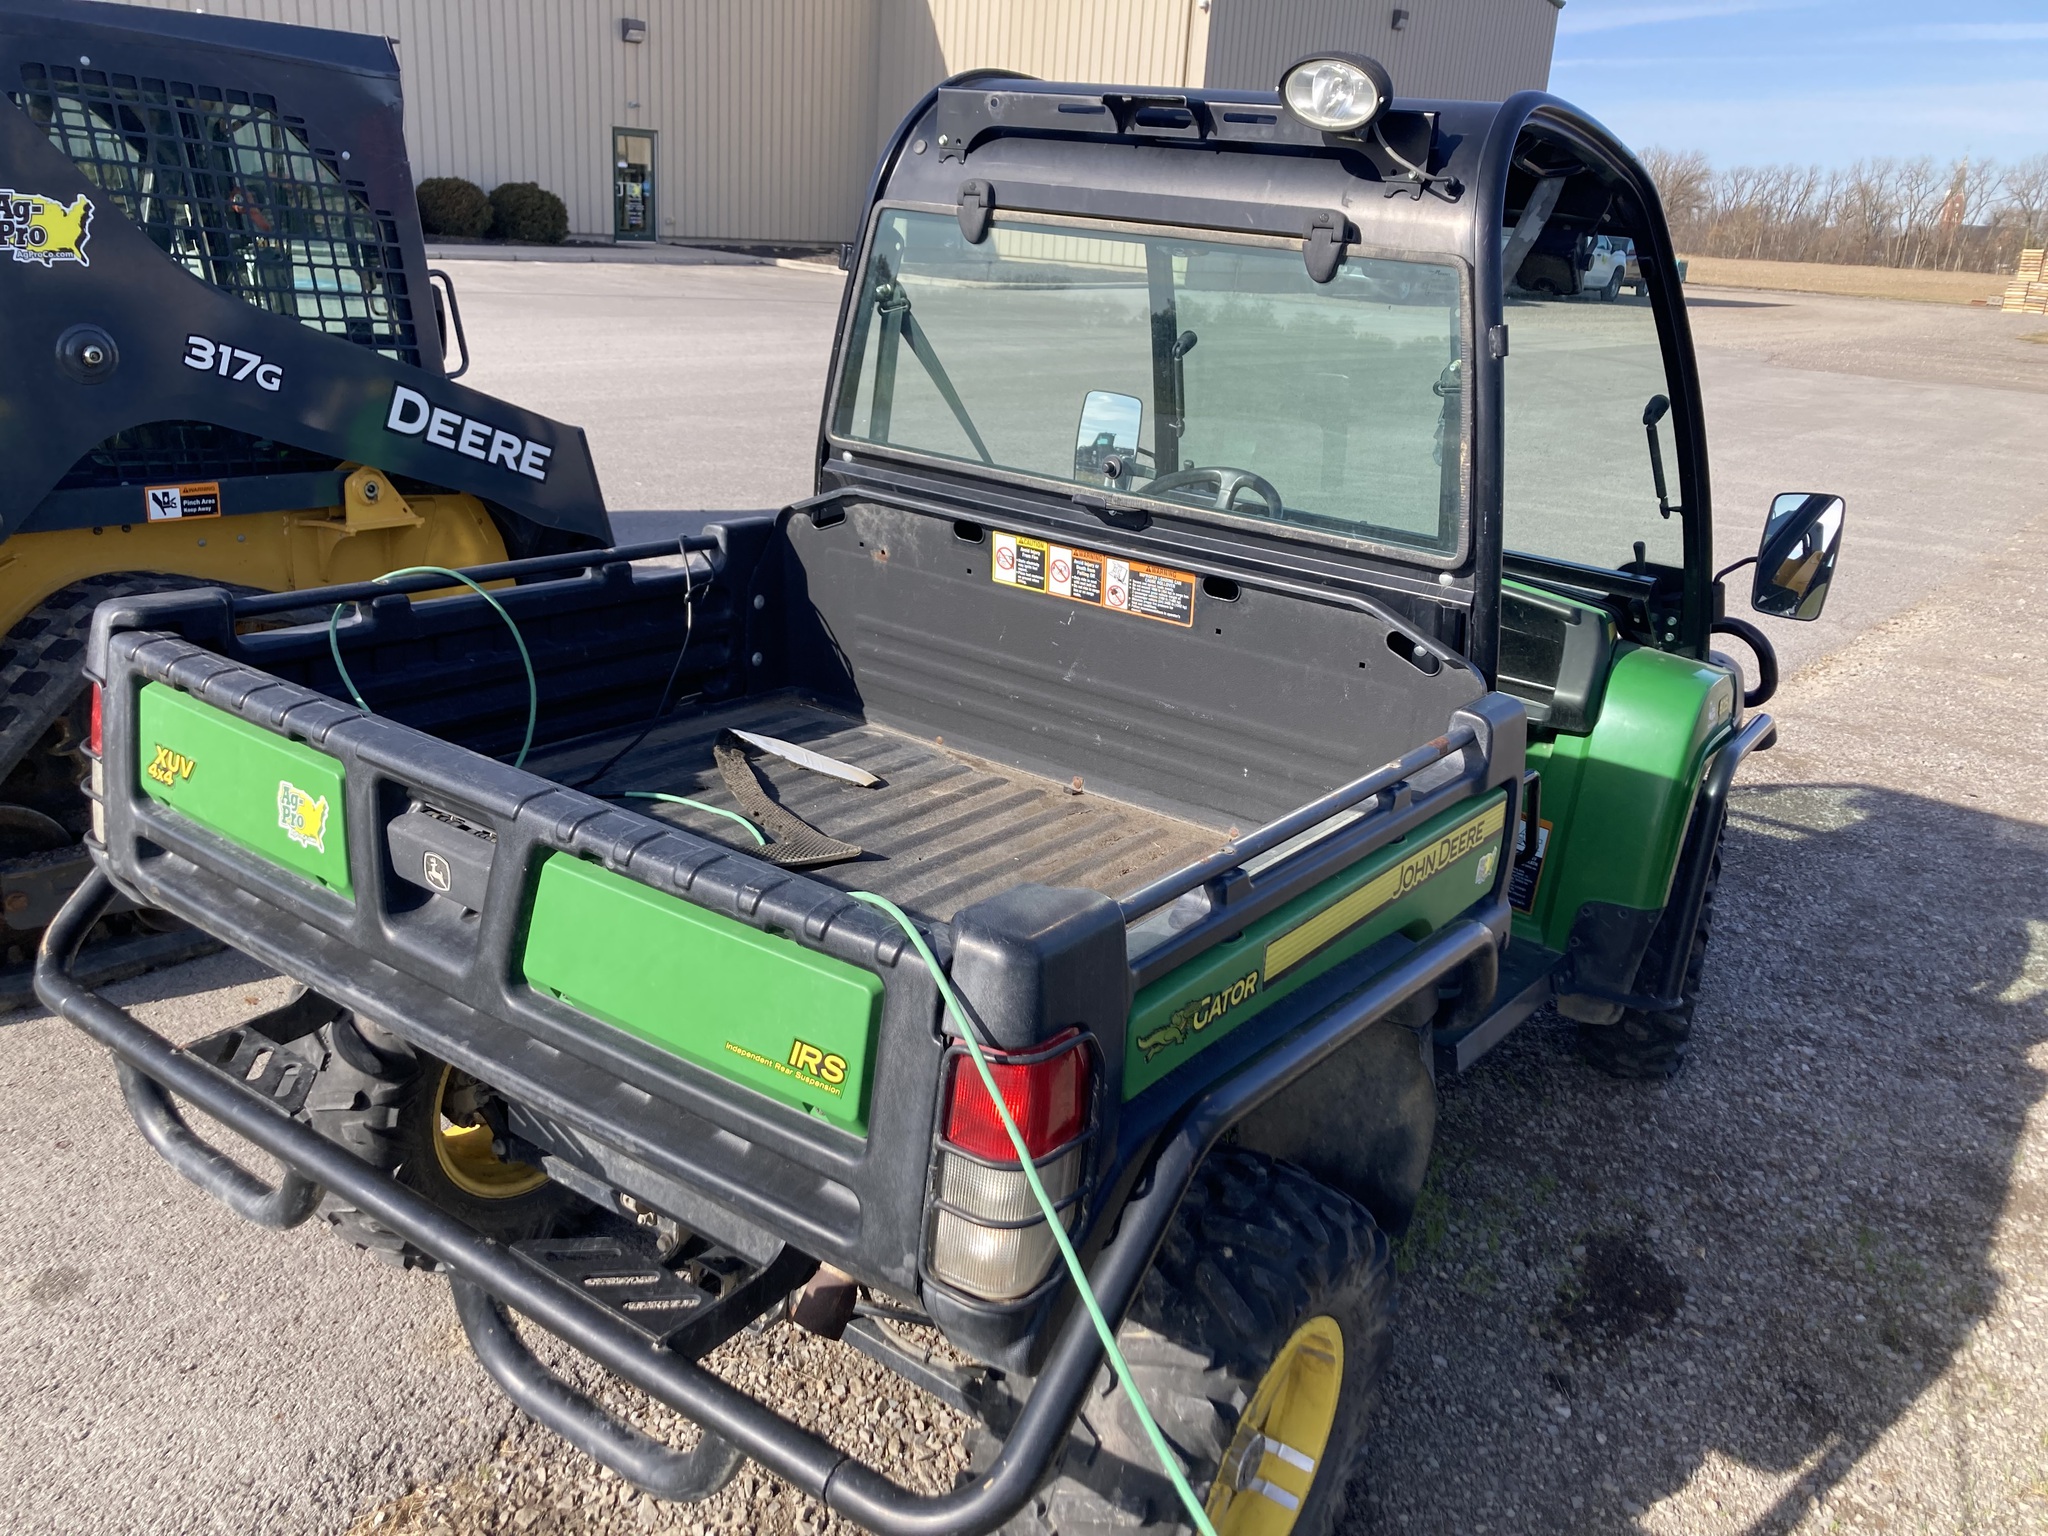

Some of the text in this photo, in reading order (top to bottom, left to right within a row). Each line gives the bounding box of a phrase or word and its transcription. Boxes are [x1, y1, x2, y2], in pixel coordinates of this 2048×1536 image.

[0, 193, 43, 226] Ag-
[0, 219, 47, 247] Pro
[16, 250, 75, 260] AgProCo.com
[184, 335, 284, 392] 317G
[387, 385, 552, 480] DEERE
[197, 505, 212, 513] Away
[1023, 539, 1044, 549] CAUTION
[1151, 566, 1177, 579] WARNING
[154, 744, 195, 780] XUV
[281, 786, 304, 811] Ag-
[281, 805, 304, 828] Pro
[1393, 850, 1439, 895] JOHN
[1438, 820, 1486, 868] DEERE
[1193, 971, 1258, 1031] GATOR
[725, 1041, 841, 1096] Independent Rear Suspension
[788, 1040, 847, 1084] IRS
